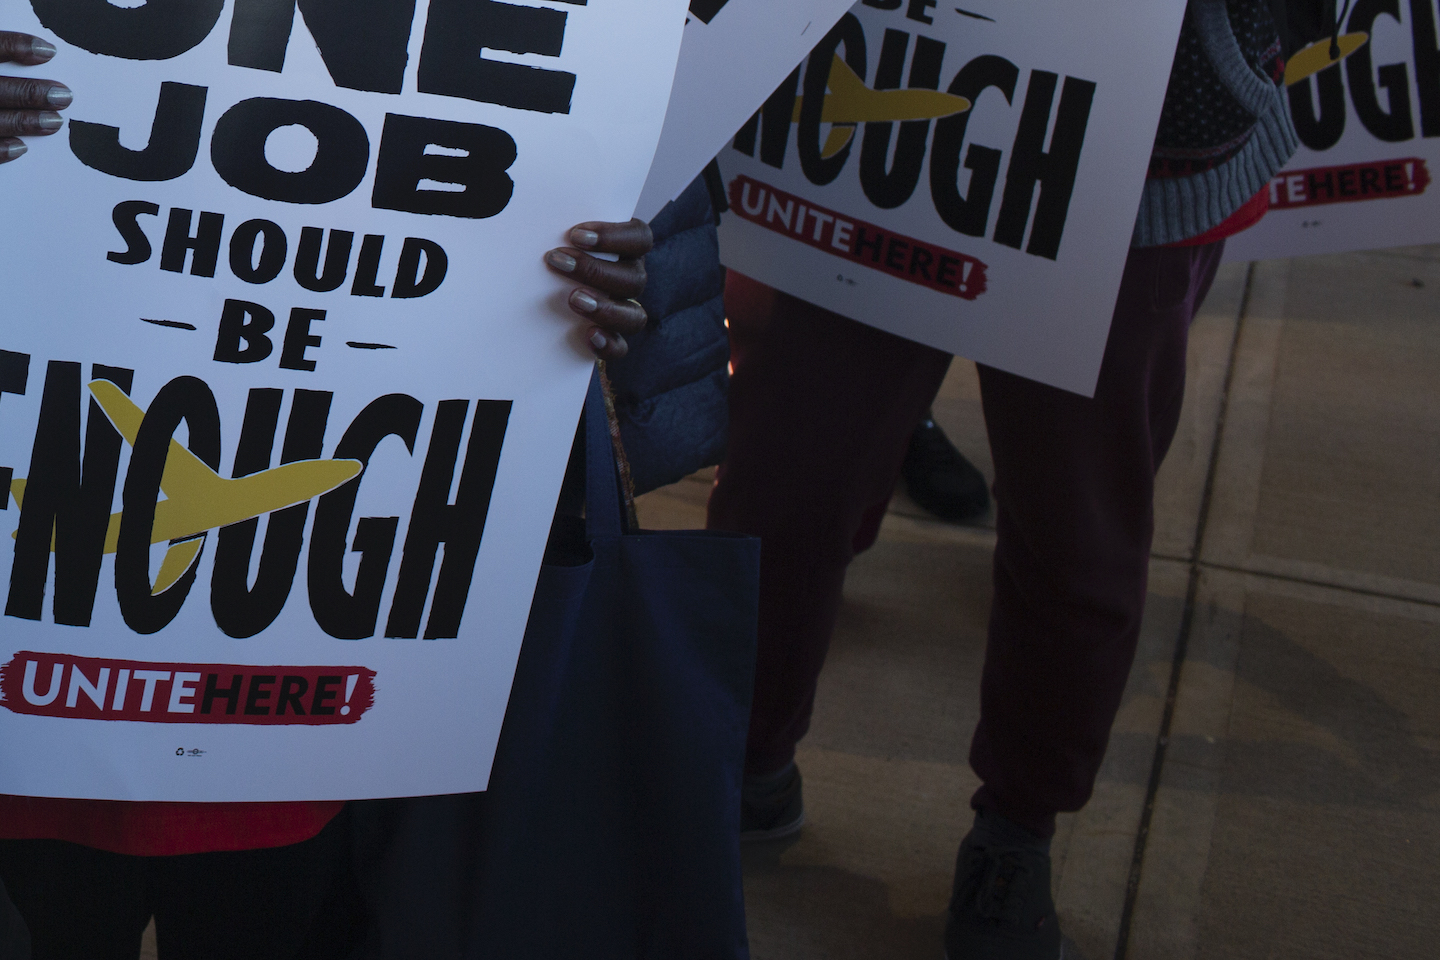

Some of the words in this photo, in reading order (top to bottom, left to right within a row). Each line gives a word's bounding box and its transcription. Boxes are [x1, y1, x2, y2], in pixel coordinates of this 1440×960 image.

[68, 81, 518, 220] JOB
[1269, 162, 1415, 205] TEHERE!
[106, 200, 449, 299] SHOULD
[213, 298, 328, 372] BE
